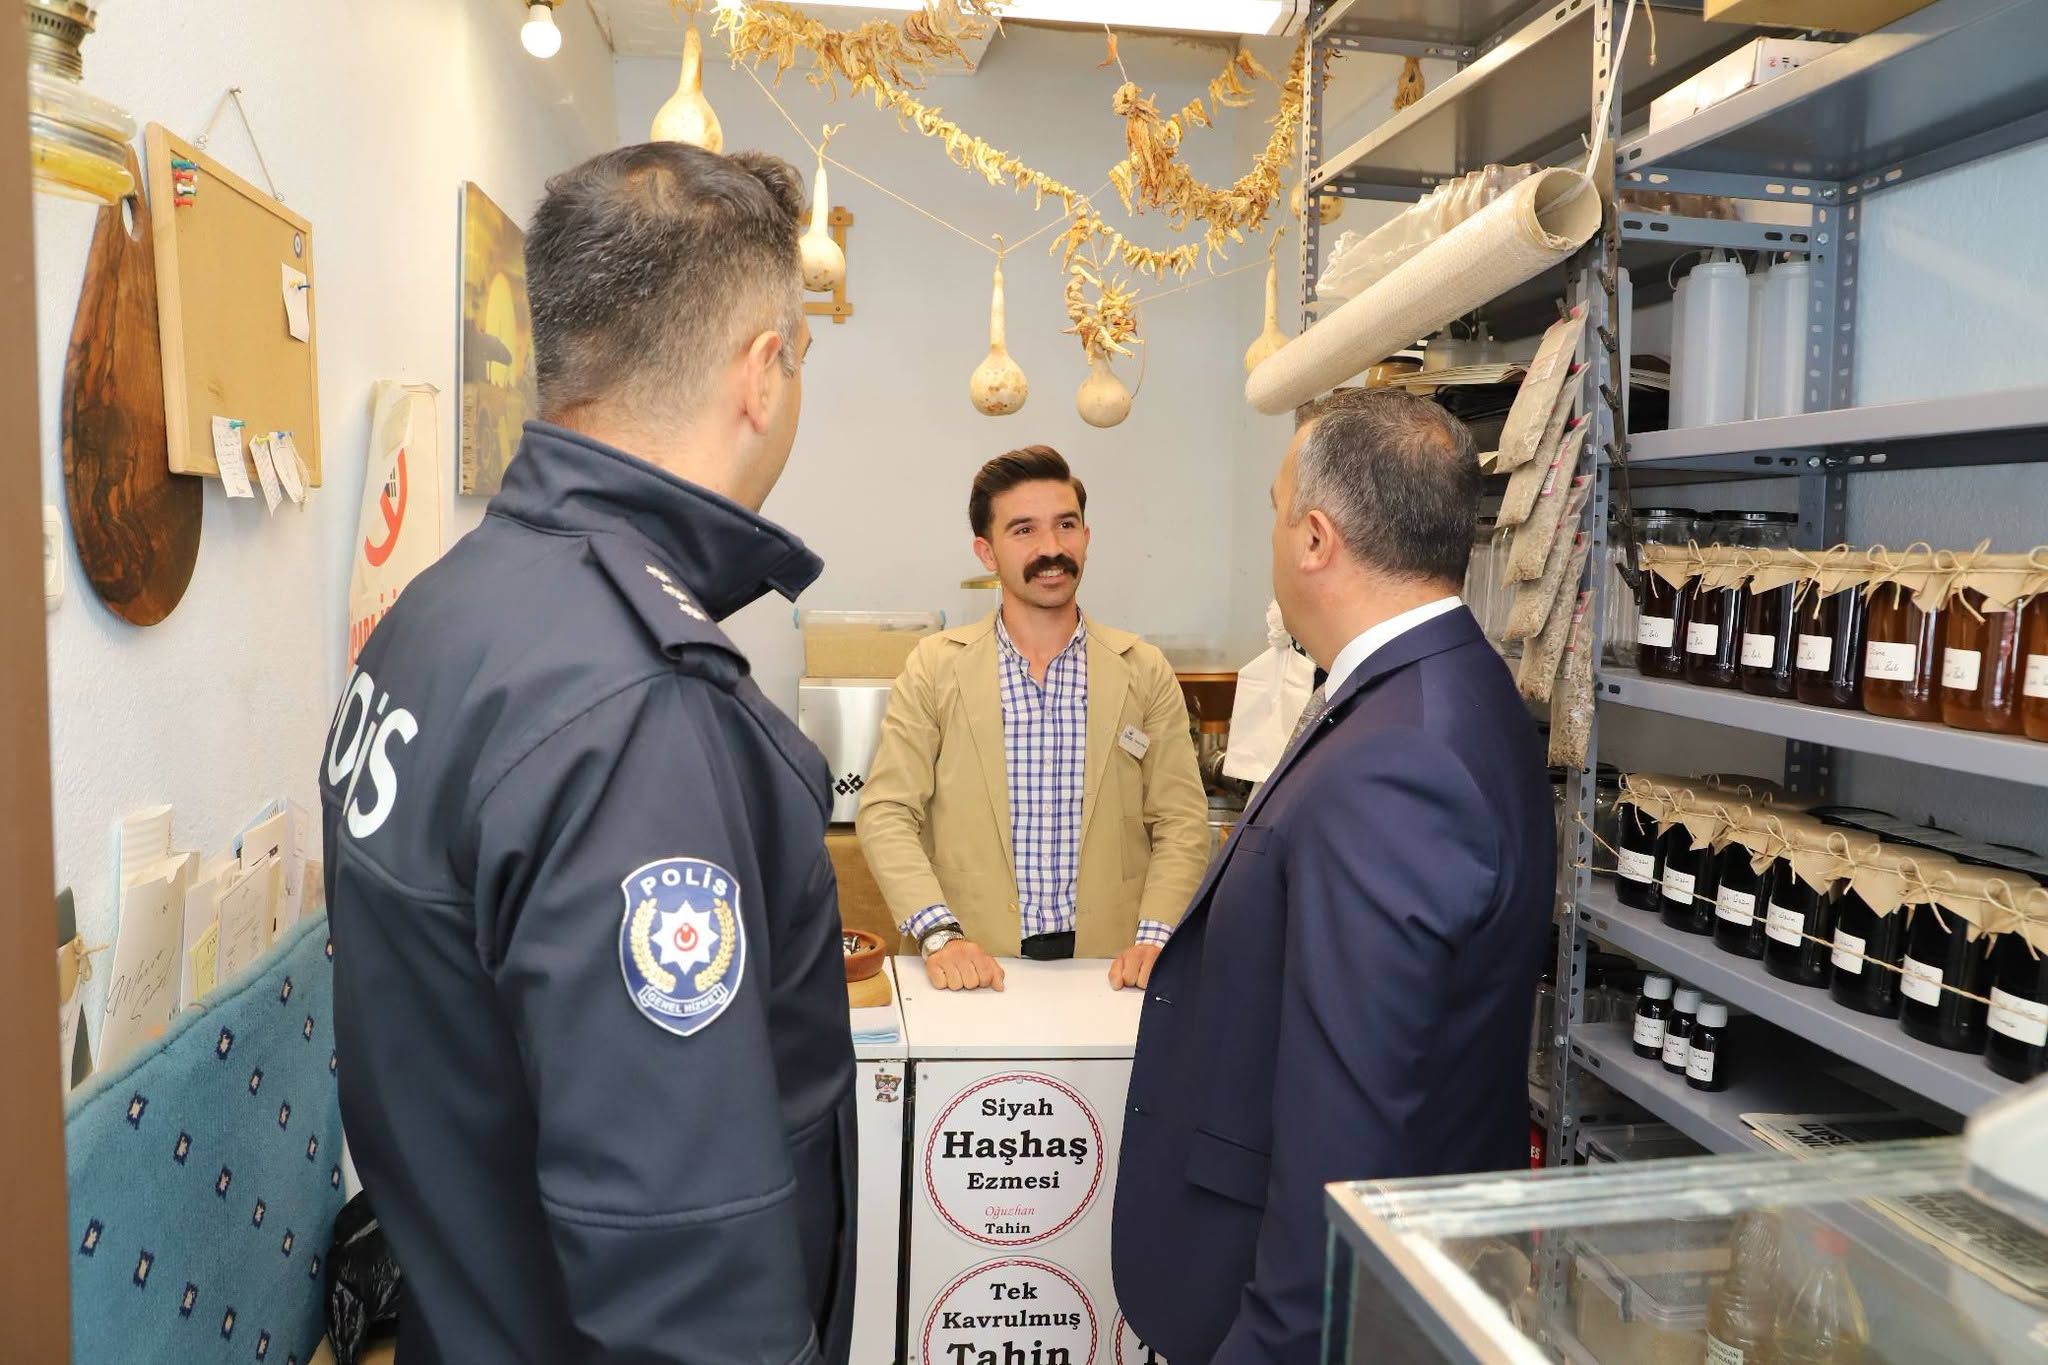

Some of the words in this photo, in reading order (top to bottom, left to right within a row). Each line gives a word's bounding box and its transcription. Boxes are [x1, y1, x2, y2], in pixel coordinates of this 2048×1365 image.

[639, 867, 729, 897] POLİS
[981, 1098, 1054, 1121] Siyah
[941, 1130, 1088, 1165] Haşhaş
[966, 1171, 1061, 1190] Ezmesi
[984, 1203, 1036, 1219] Oğuzhan
[984, 1223, 1032, 1235] Tahin
[989, 1282, 1039, 1301] Tek
[941, 1309, 1082, 1330] Kavrulmuş
[946, 1340, 1072, 1365] Tahin
